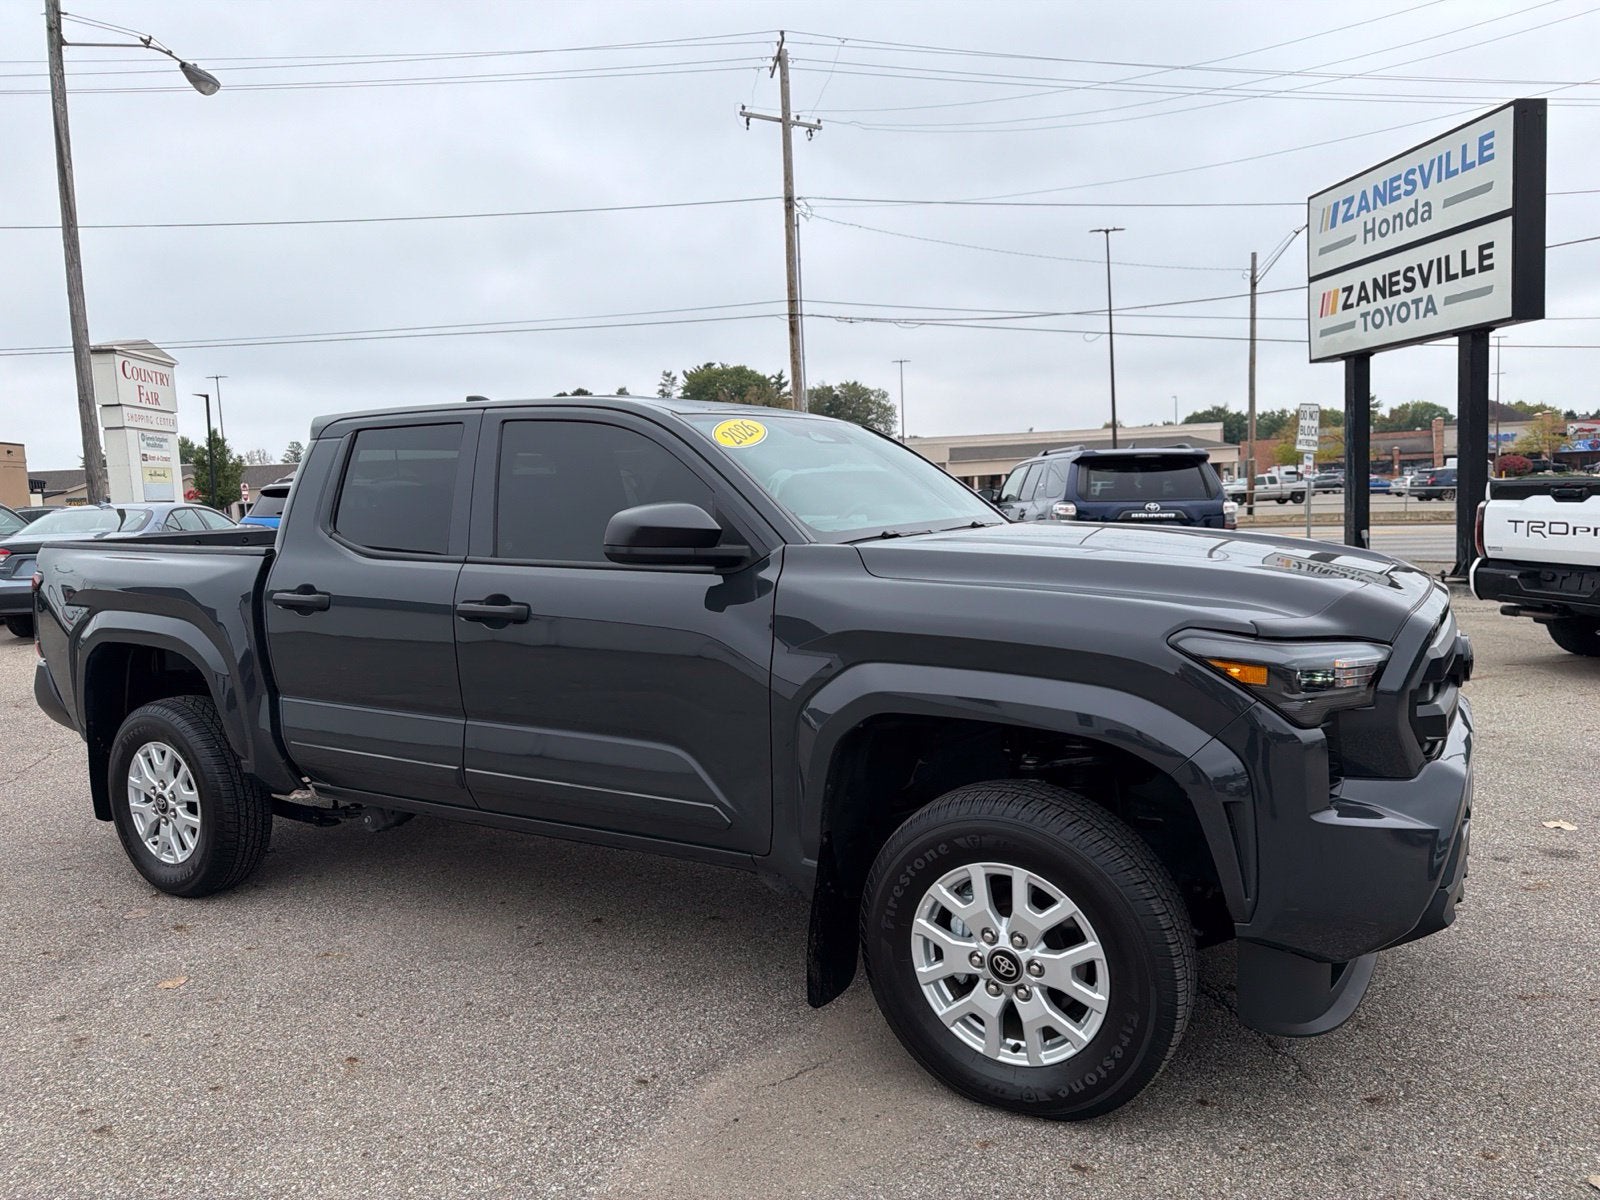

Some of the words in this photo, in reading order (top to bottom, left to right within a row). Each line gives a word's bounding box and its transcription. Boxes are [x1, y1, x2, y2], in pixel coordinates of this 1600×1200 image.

[1341, 130, 1495, 224] ZANESVILLE
[1363, 198, 1433, 245] Honda
[1341, 241, 1495, 311] ZANESVILLE
[1360, 294, 1438, 332] TOYOTA
[121, 359, 170, 387] COUNTRY
[137, 384, 161, 406] FAIR
[127, 412, 153, 425] SHOPPING
[155, 416, 175, 427] CENTER
[1300, 410, 1307, 420] DO
[1308, 410, 1319, 421] NOT
[721, 421, 760, 445] 2026
[1300, 425, 1318, 436] BLOCK
[1507, 519, 1569, 539] TRD
[880, 842, 950, 930] Firestone
[1057, 1012, 1139, 1098] Firestone
